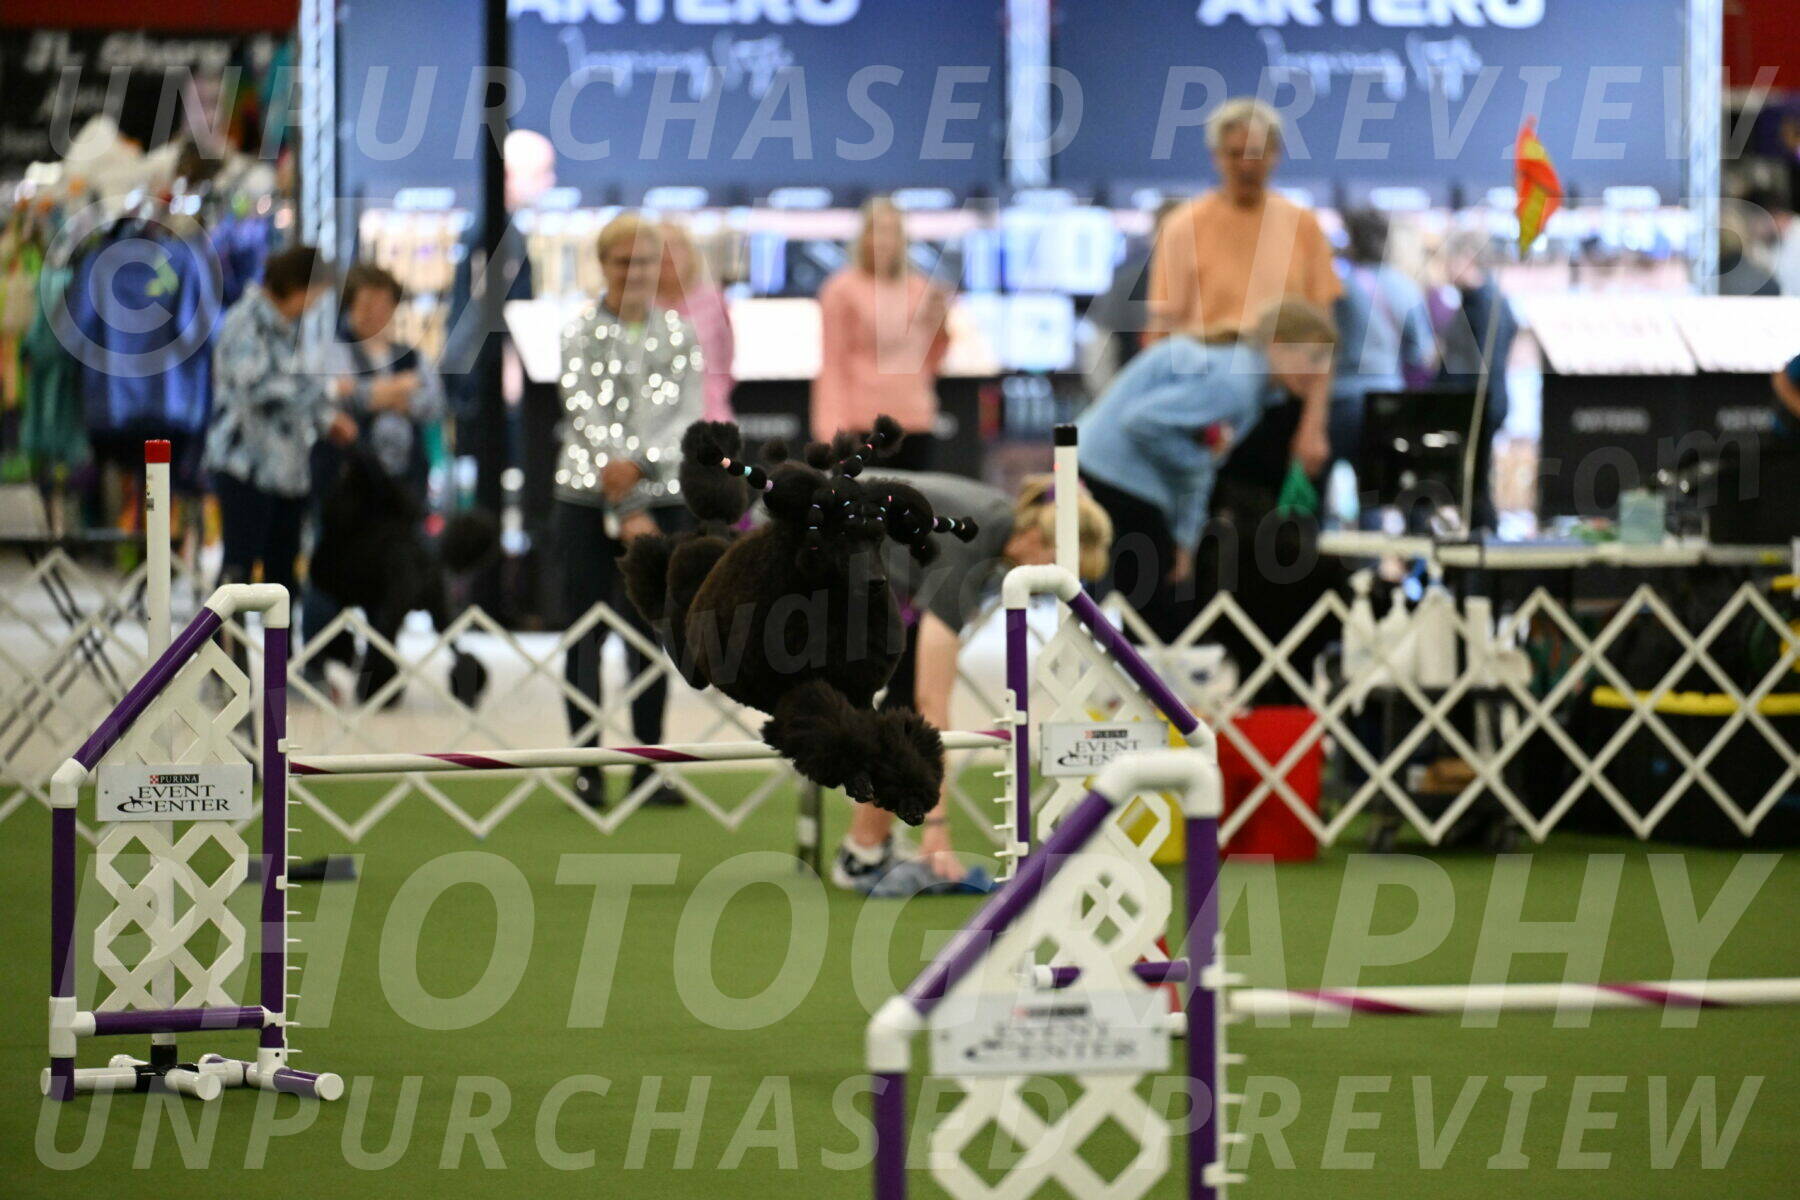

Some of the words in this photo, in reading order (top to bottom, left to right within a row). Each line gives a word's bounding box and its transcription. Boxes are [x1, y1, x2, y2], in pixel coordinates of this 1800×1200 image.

[160, 774, 199, 784] PURINA
[138, 785, 216, 799] EVENT
[117, 798, 230, 813] CENTER
